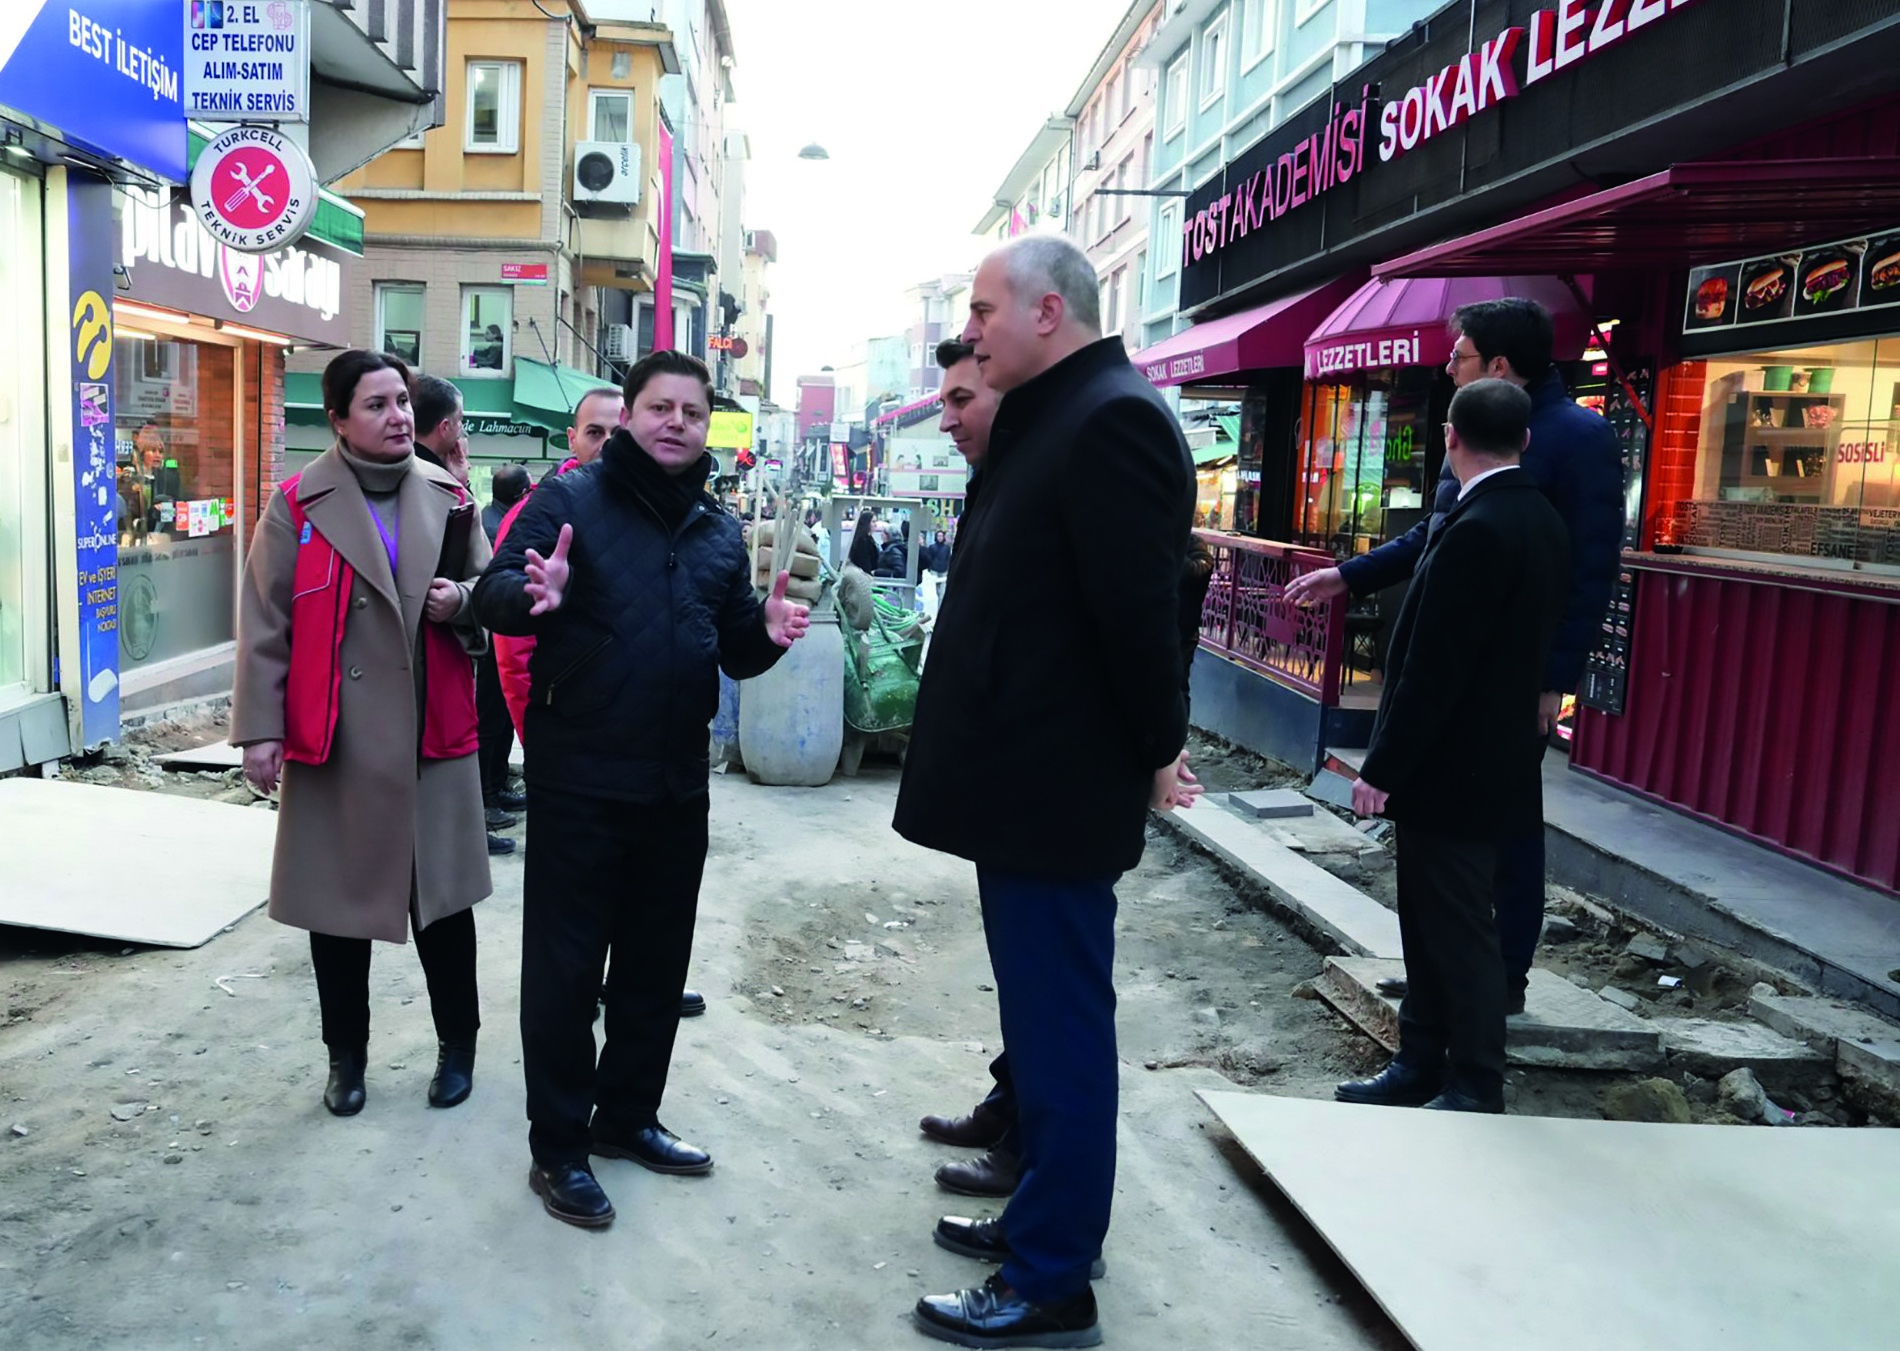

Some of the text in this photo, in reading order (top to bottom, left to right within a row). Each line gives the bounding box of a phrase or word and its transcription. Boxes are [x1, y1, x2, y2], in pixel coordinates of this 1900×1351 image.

[226, 5, 260, 23] 2. EL
[191, 33, 295, 52] CEP TELEFONU
[69, 8, 178, 103] BEST İLETİŞİM
[203, 61, 283, 80] ALIM-SATIM
[191, 88, 295, 112] TEKNİK SERVİS
[1379, 27, 1519, 162] SOKAK
[213, 129, 283, 154] TURKCELL
[1183, 83, 1374, 268] TOST AKADEMİSİ
[1316, 330, 1420, 376] LEZZETLERİ
[1146, 362, 1168, 382] SOKAK
[479, 420, 532, 434] Lahmacun
